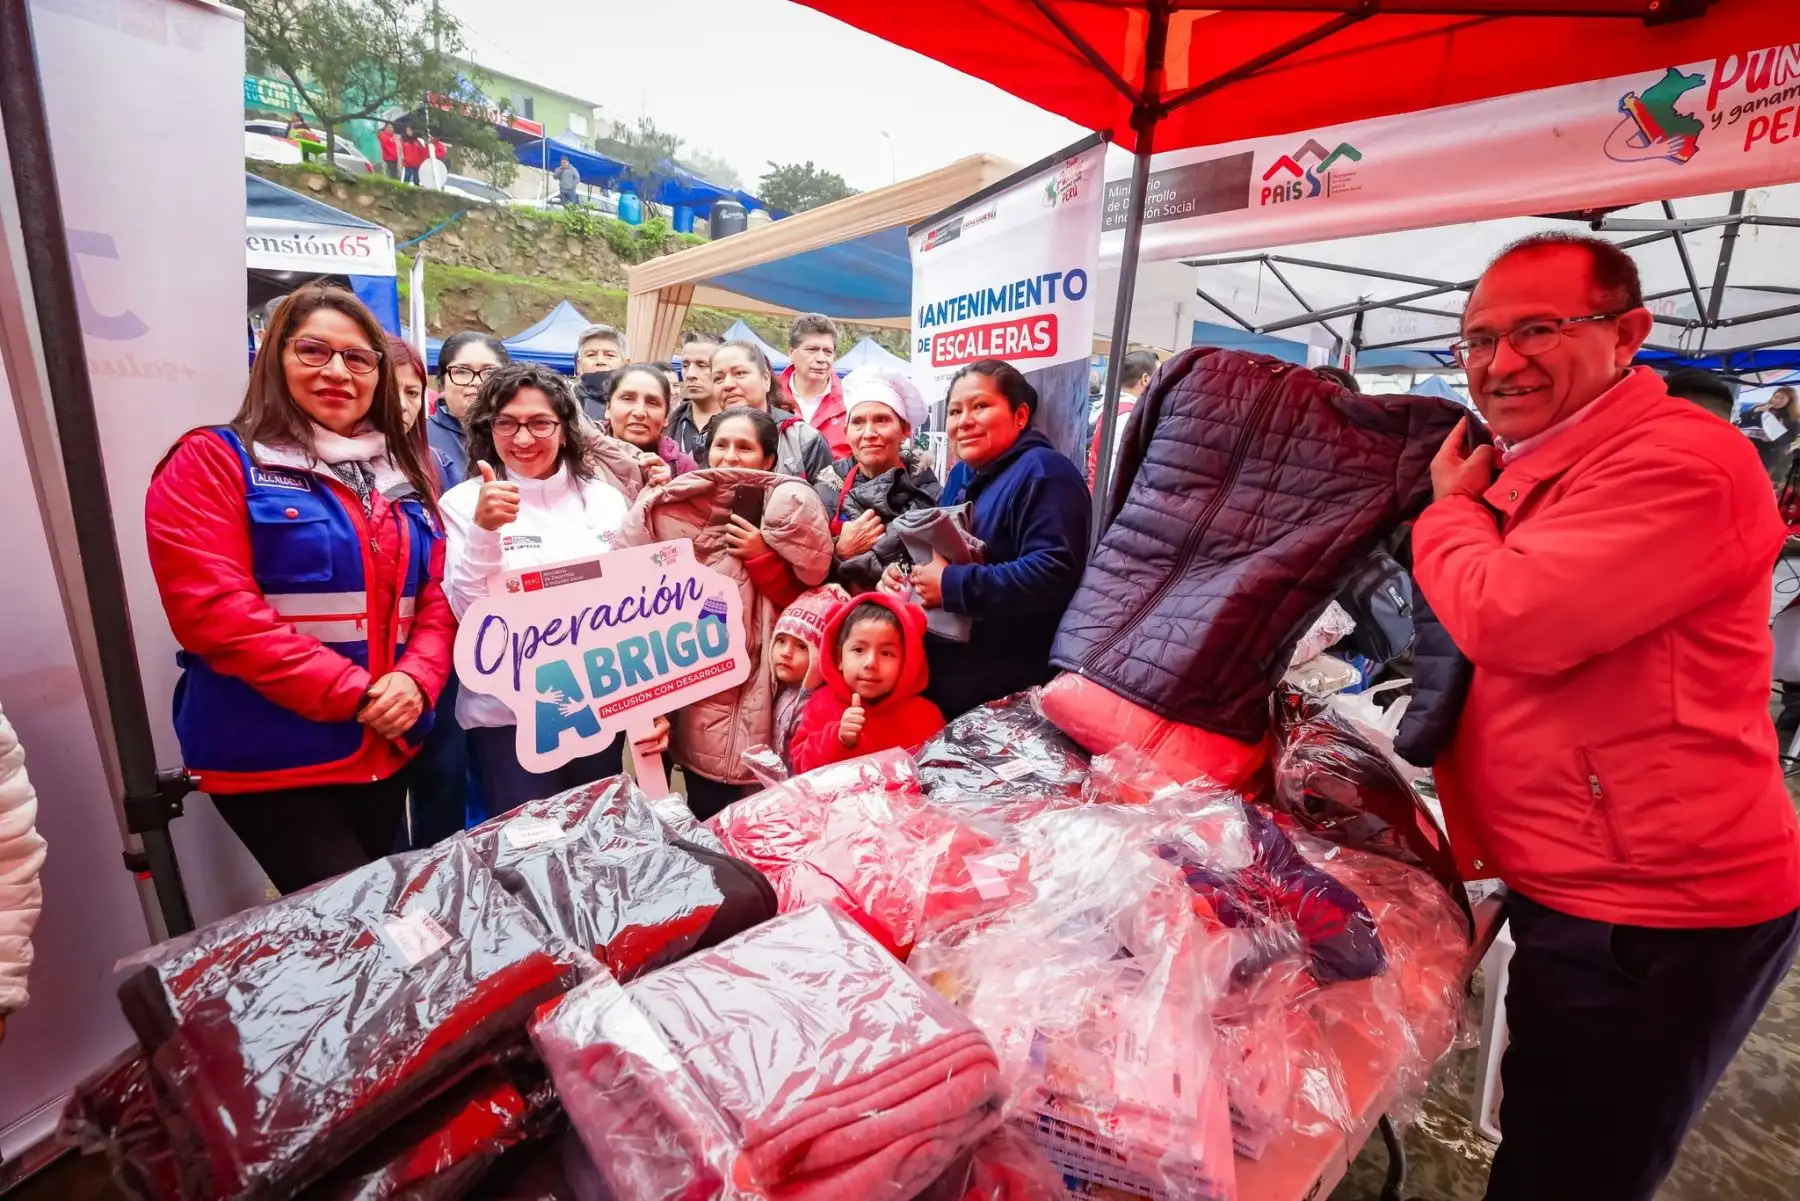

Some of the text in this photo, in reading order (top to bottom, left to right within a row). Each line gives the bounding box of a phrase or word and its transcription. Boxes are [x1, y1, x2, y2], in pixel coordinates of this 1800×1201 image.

[1711, 111, 1723, 131] y
[1108, 180, 1160, 198] Minirio
[1108, 189, 1176, 212] de Drrollo
[1106, 199, 1196, 226] e Inción Social
[918, 321, 1051, 361] DE ESCALERAS
[475, 574, 704, 691] Operación
[535, 613, 729, 754] ABRIGO
[601, 660, 733, 717] INCLUSIÓN CON DESARROLLO
